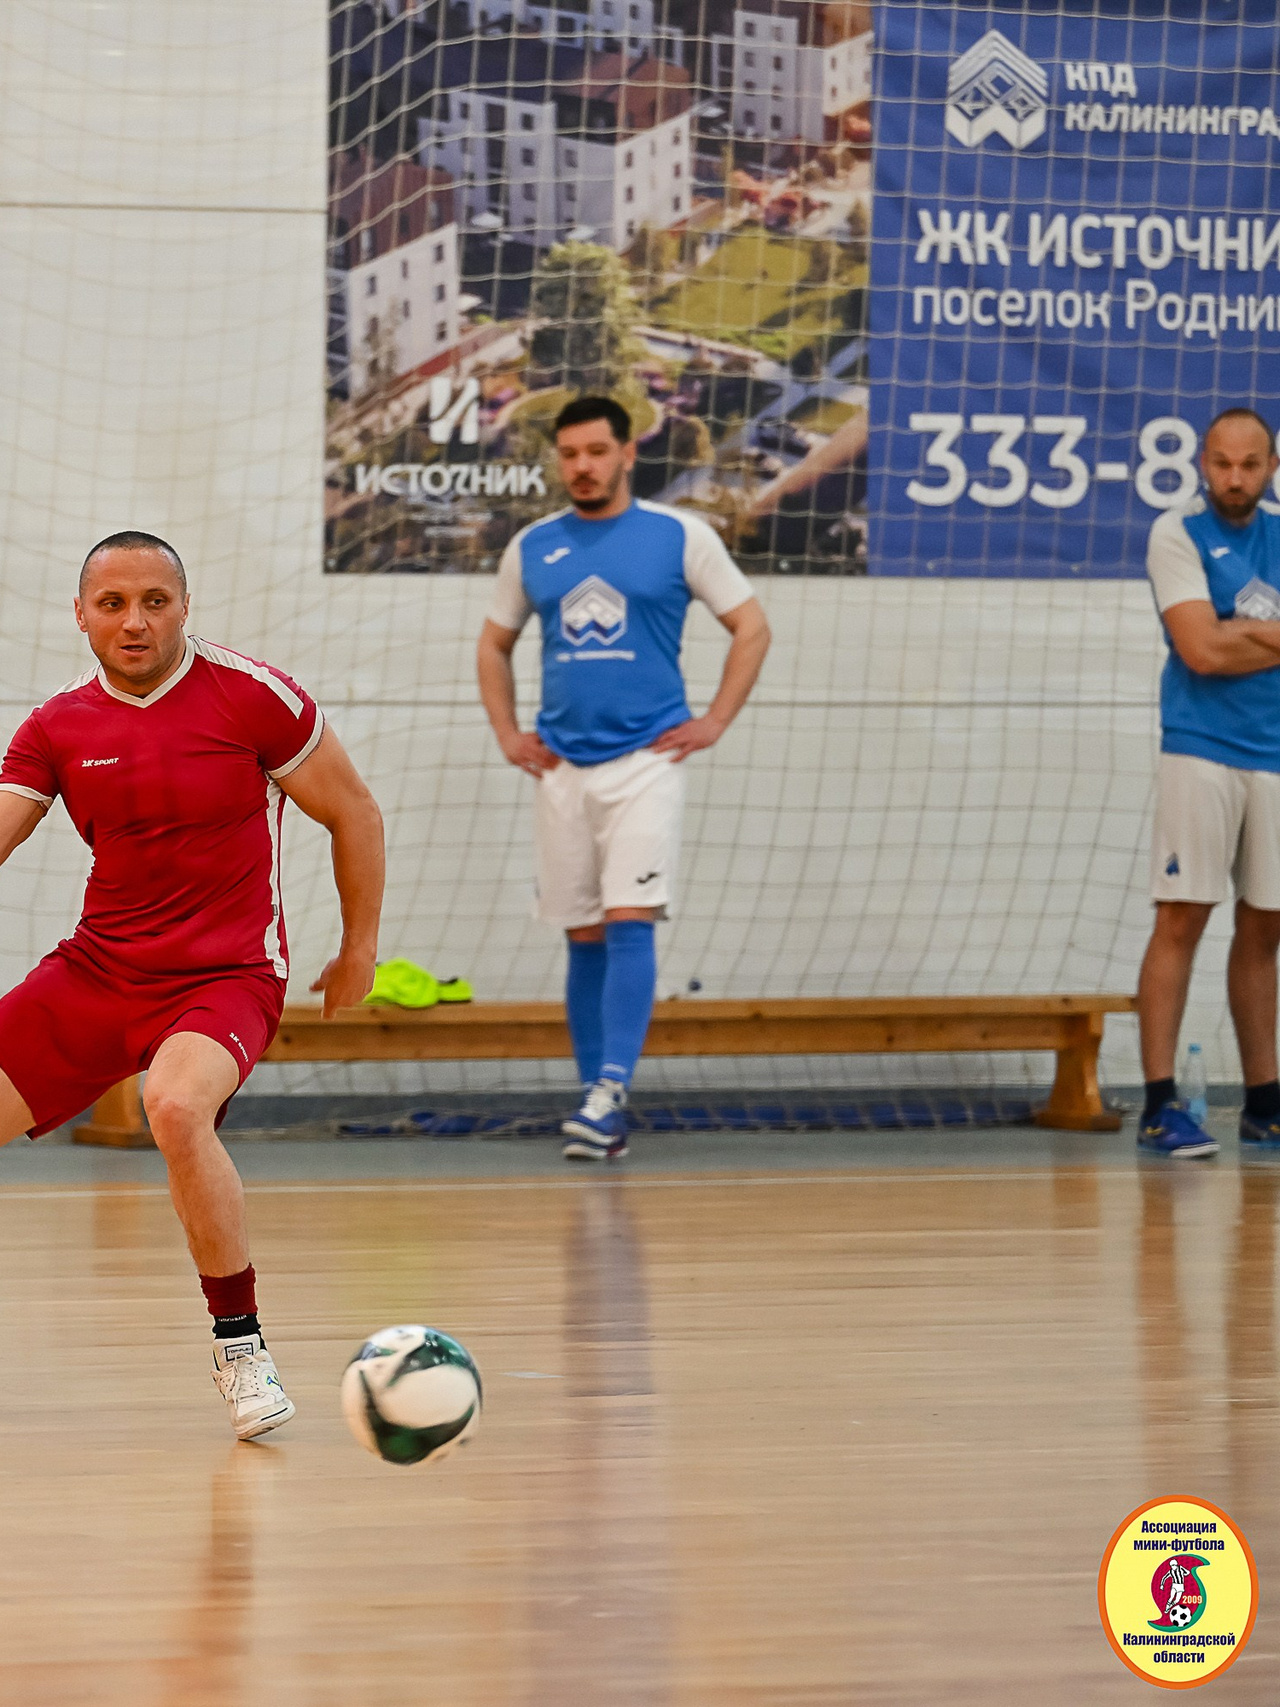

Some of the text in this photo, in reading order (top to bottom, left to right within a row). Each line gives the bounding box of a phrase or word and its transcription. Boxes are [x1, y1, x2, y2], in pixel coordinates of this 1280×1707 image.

[1065, 62, 1137, 98] КПД
[1064, 103, 1280, 141] КАЛИНИНГРА
[915, 209, 1011, 266] ЖК
[913, 278, 1280, 339] поселок Родни
[93, 757, 120, 767] SPORT
